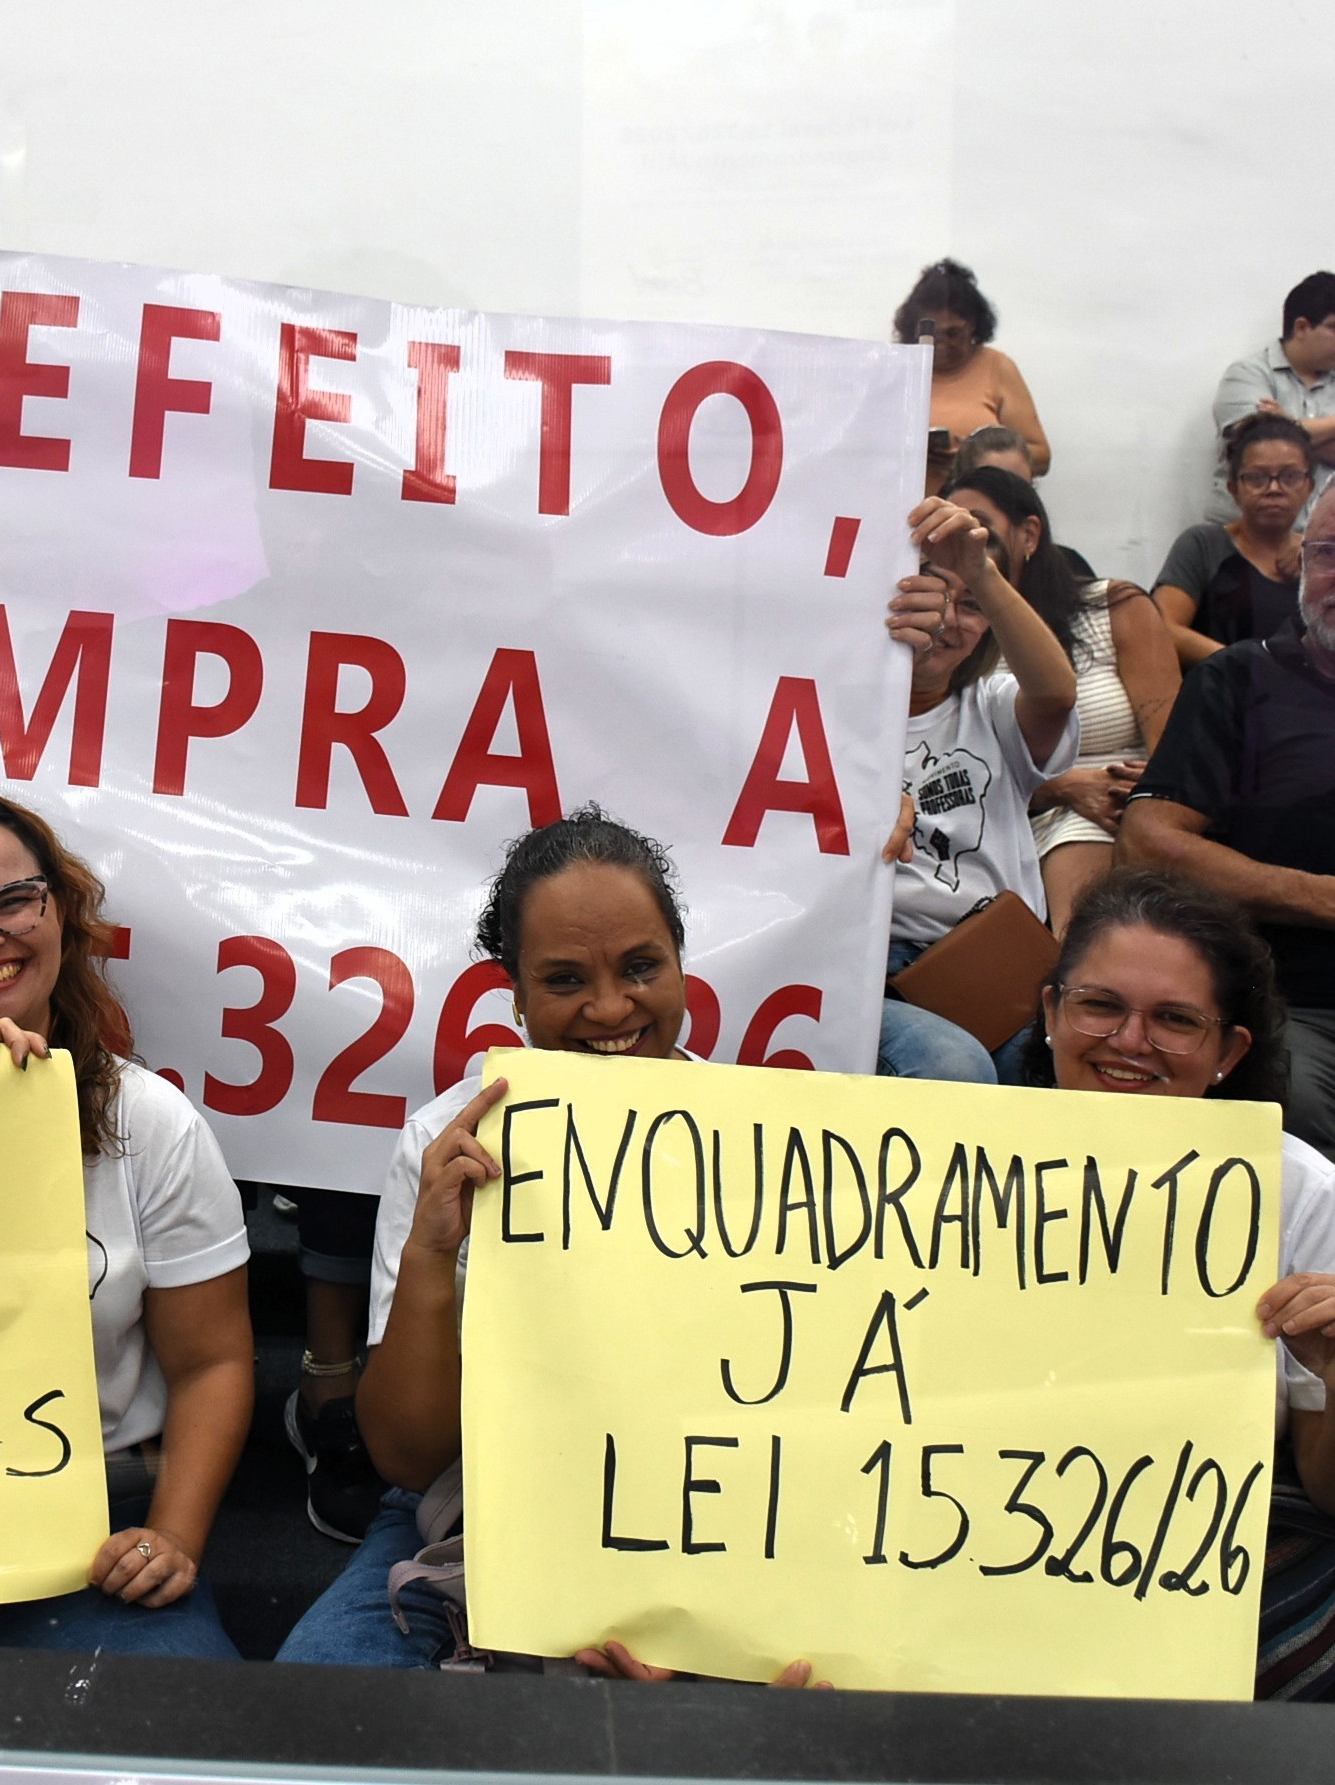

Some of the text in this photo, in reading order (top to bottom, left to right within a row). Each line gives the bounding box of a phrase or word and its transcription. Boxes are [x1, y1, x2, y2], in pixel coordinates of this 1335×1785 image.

[721, 675, 851, 857] A
[500, 1097, 1261, 1299] ENQUADRAMENTO
[720, 1280, 932, 1426] JÁ
[600, 1433, 783, 1560] LEI
